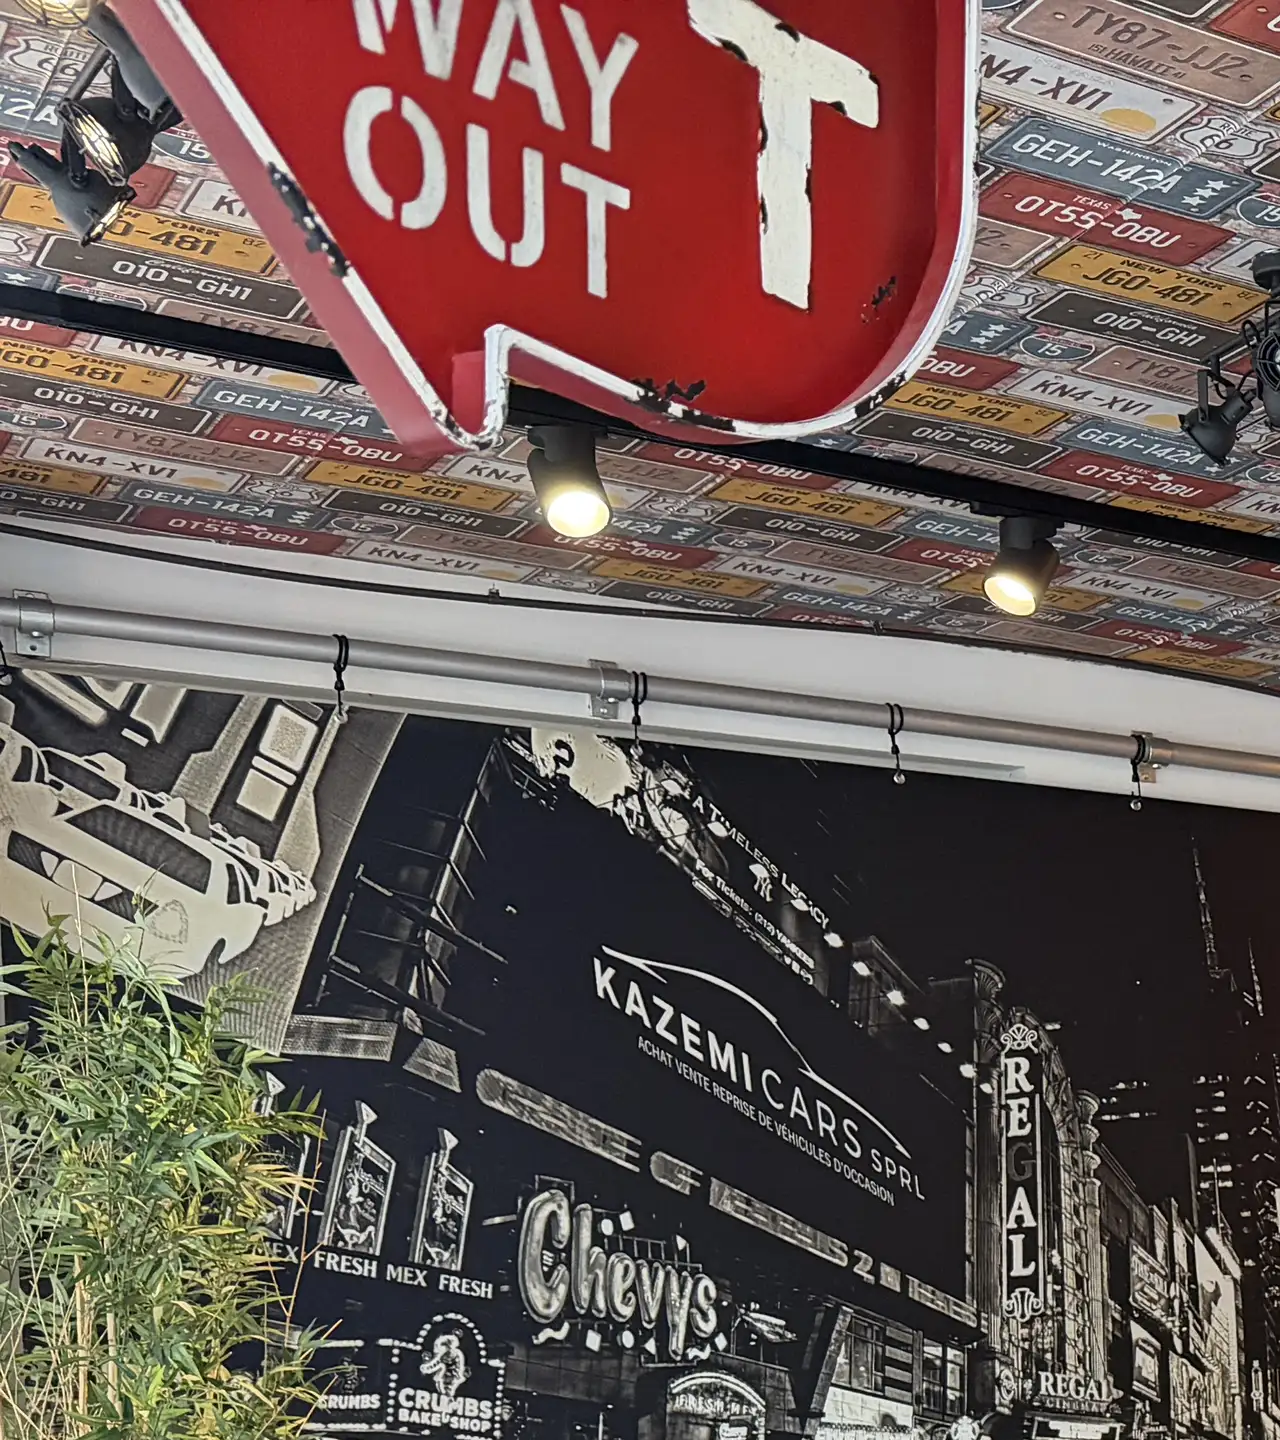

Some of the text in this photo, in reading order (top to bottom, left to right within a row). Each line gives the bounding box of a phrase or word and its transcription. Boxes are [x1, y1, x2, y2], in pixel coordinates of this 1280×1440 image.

[1012, 133, 1184, 194] GEH-142A
[343, 85, 631, 299] OUT
[213, 390, 368, 428] GEH-142A
[1077, 429, 1205, 465] GEH-142A
[134, 488, 275, 519] GEH-142A
[593, 957, 926, 1200] KAZEMI CARS SPRL
[637, 1035, 896, 1207] ACHAT VENTE REPRISE DE VÉHICULES D'OCCASION
[1004, 1056, 1038, 1277] REGAL
[313, 1250, 379, 1279] FRESH
[385, 1263, 429, 1288] MEX
[438, 1273, 494, 1300] FRESH
[517, 1189, 718, 1361] Chevys
[398, 1387, 494, 1420] CRUMBS
[1038, 1370, 1112, 1402] REGAL
[450, 1412, 492, 1433] SHOP
